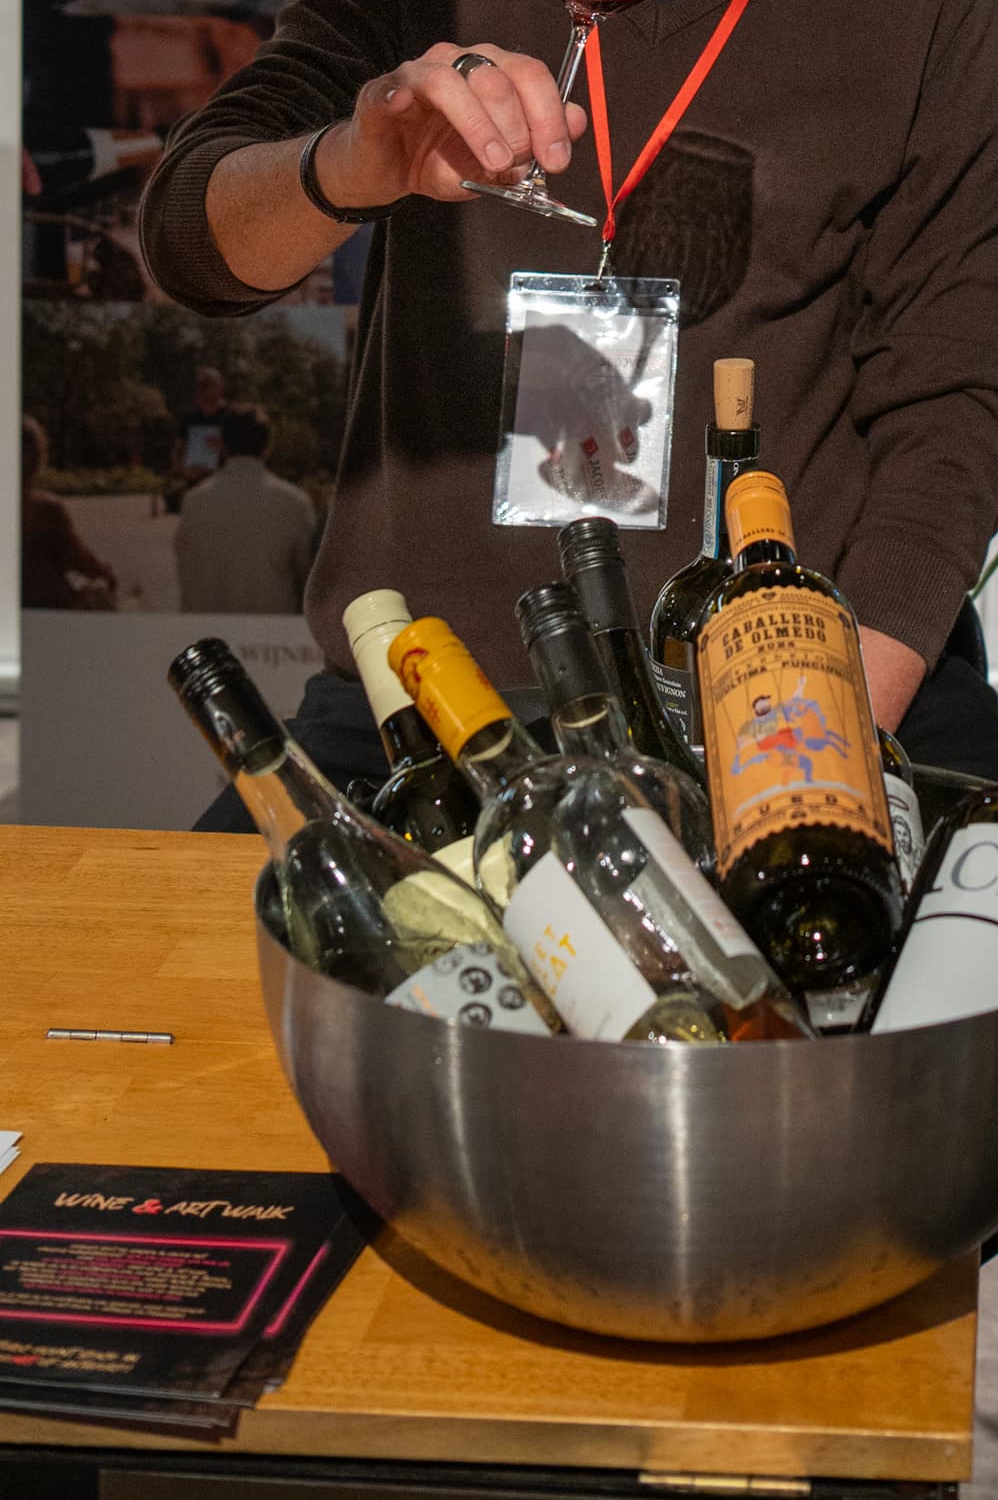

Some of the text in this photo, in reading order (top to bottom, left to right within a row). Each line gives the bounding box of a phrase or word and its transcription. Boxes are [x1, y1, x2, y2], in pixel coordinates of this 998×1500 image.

[722, 613, 826, 647] CABALLERO
[725, 626, 827, 660] DE OLMEDO
